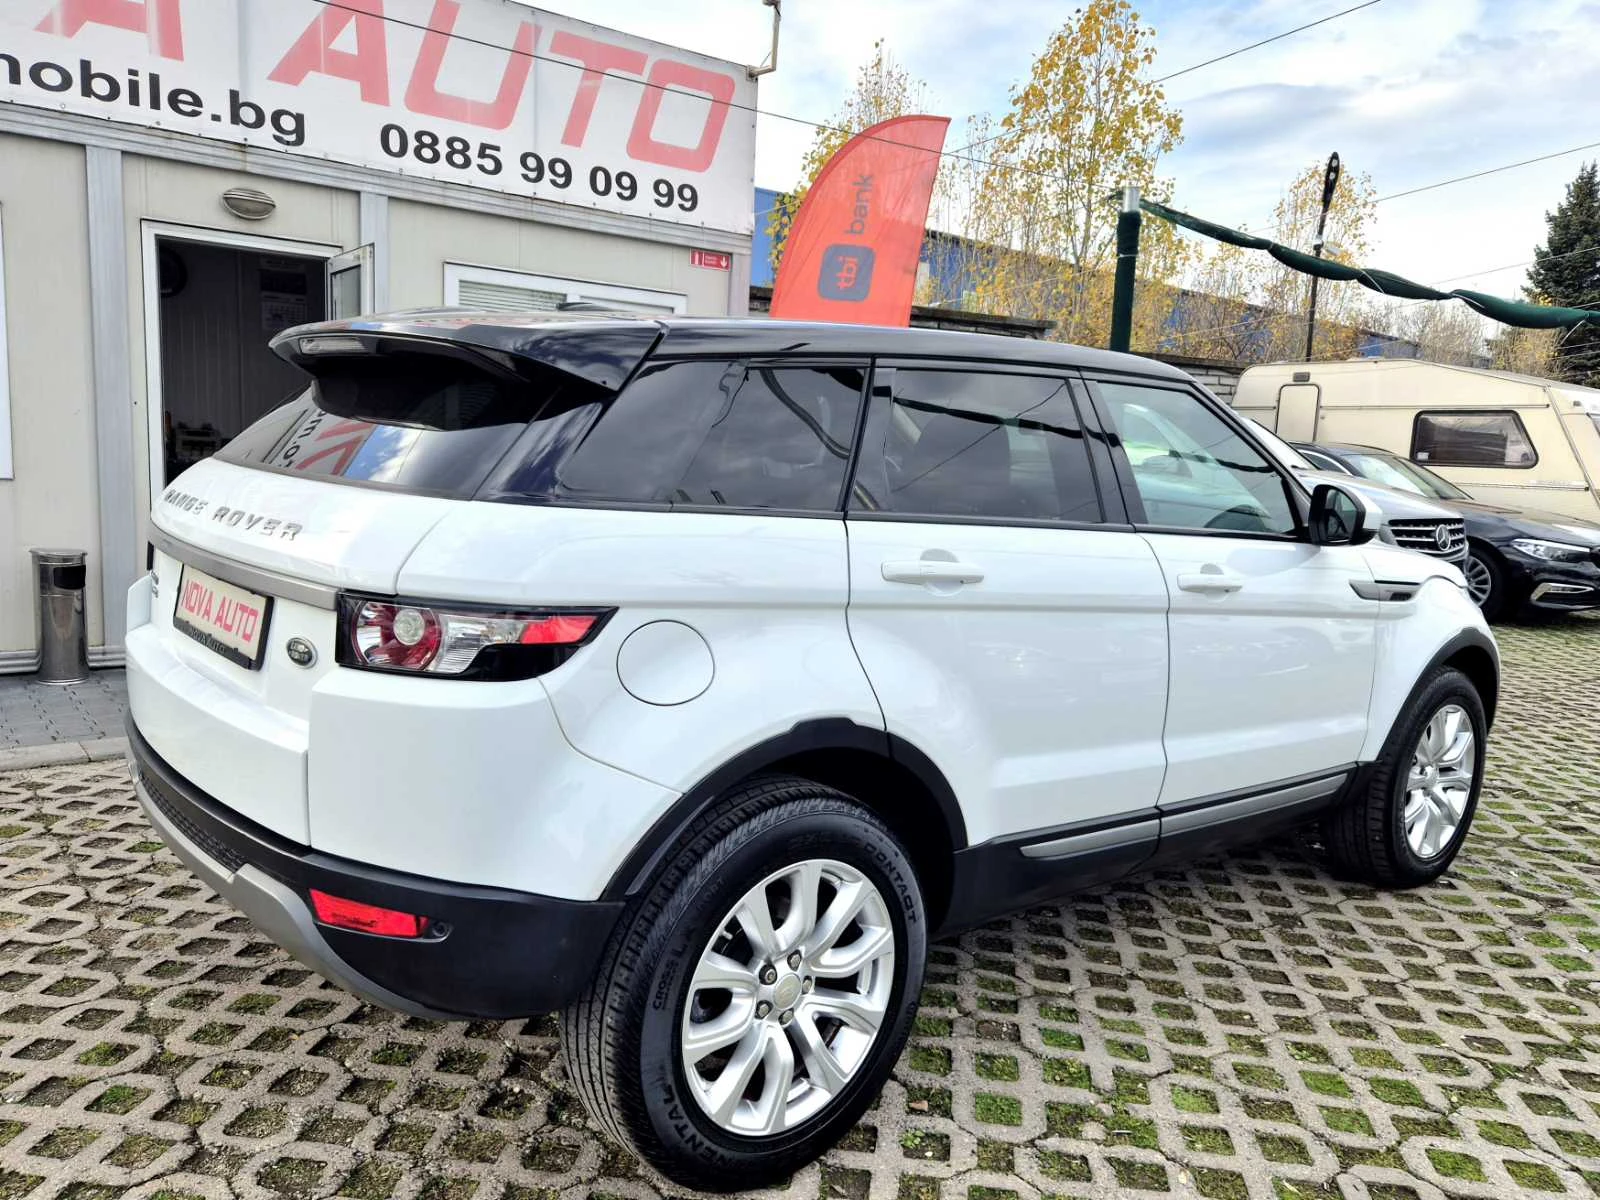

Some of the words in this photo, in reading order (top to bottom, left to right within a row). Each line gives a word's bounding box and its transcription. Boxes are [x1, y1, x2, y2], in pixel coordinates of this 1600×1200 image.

[267, 0, 735, 173] AUTO
[379, 122, 503, 176] 0885
[519, 151, 573, 189] 99
[589, 165, 638, 202] 09
[653, 179, 699, 212] 99
[844, 174, 874, 235] bank
[211, 506, 303, 541] ROVER
[181, 579, 211, 622] NOVA
[213, 596, 260, 643] AUTO
